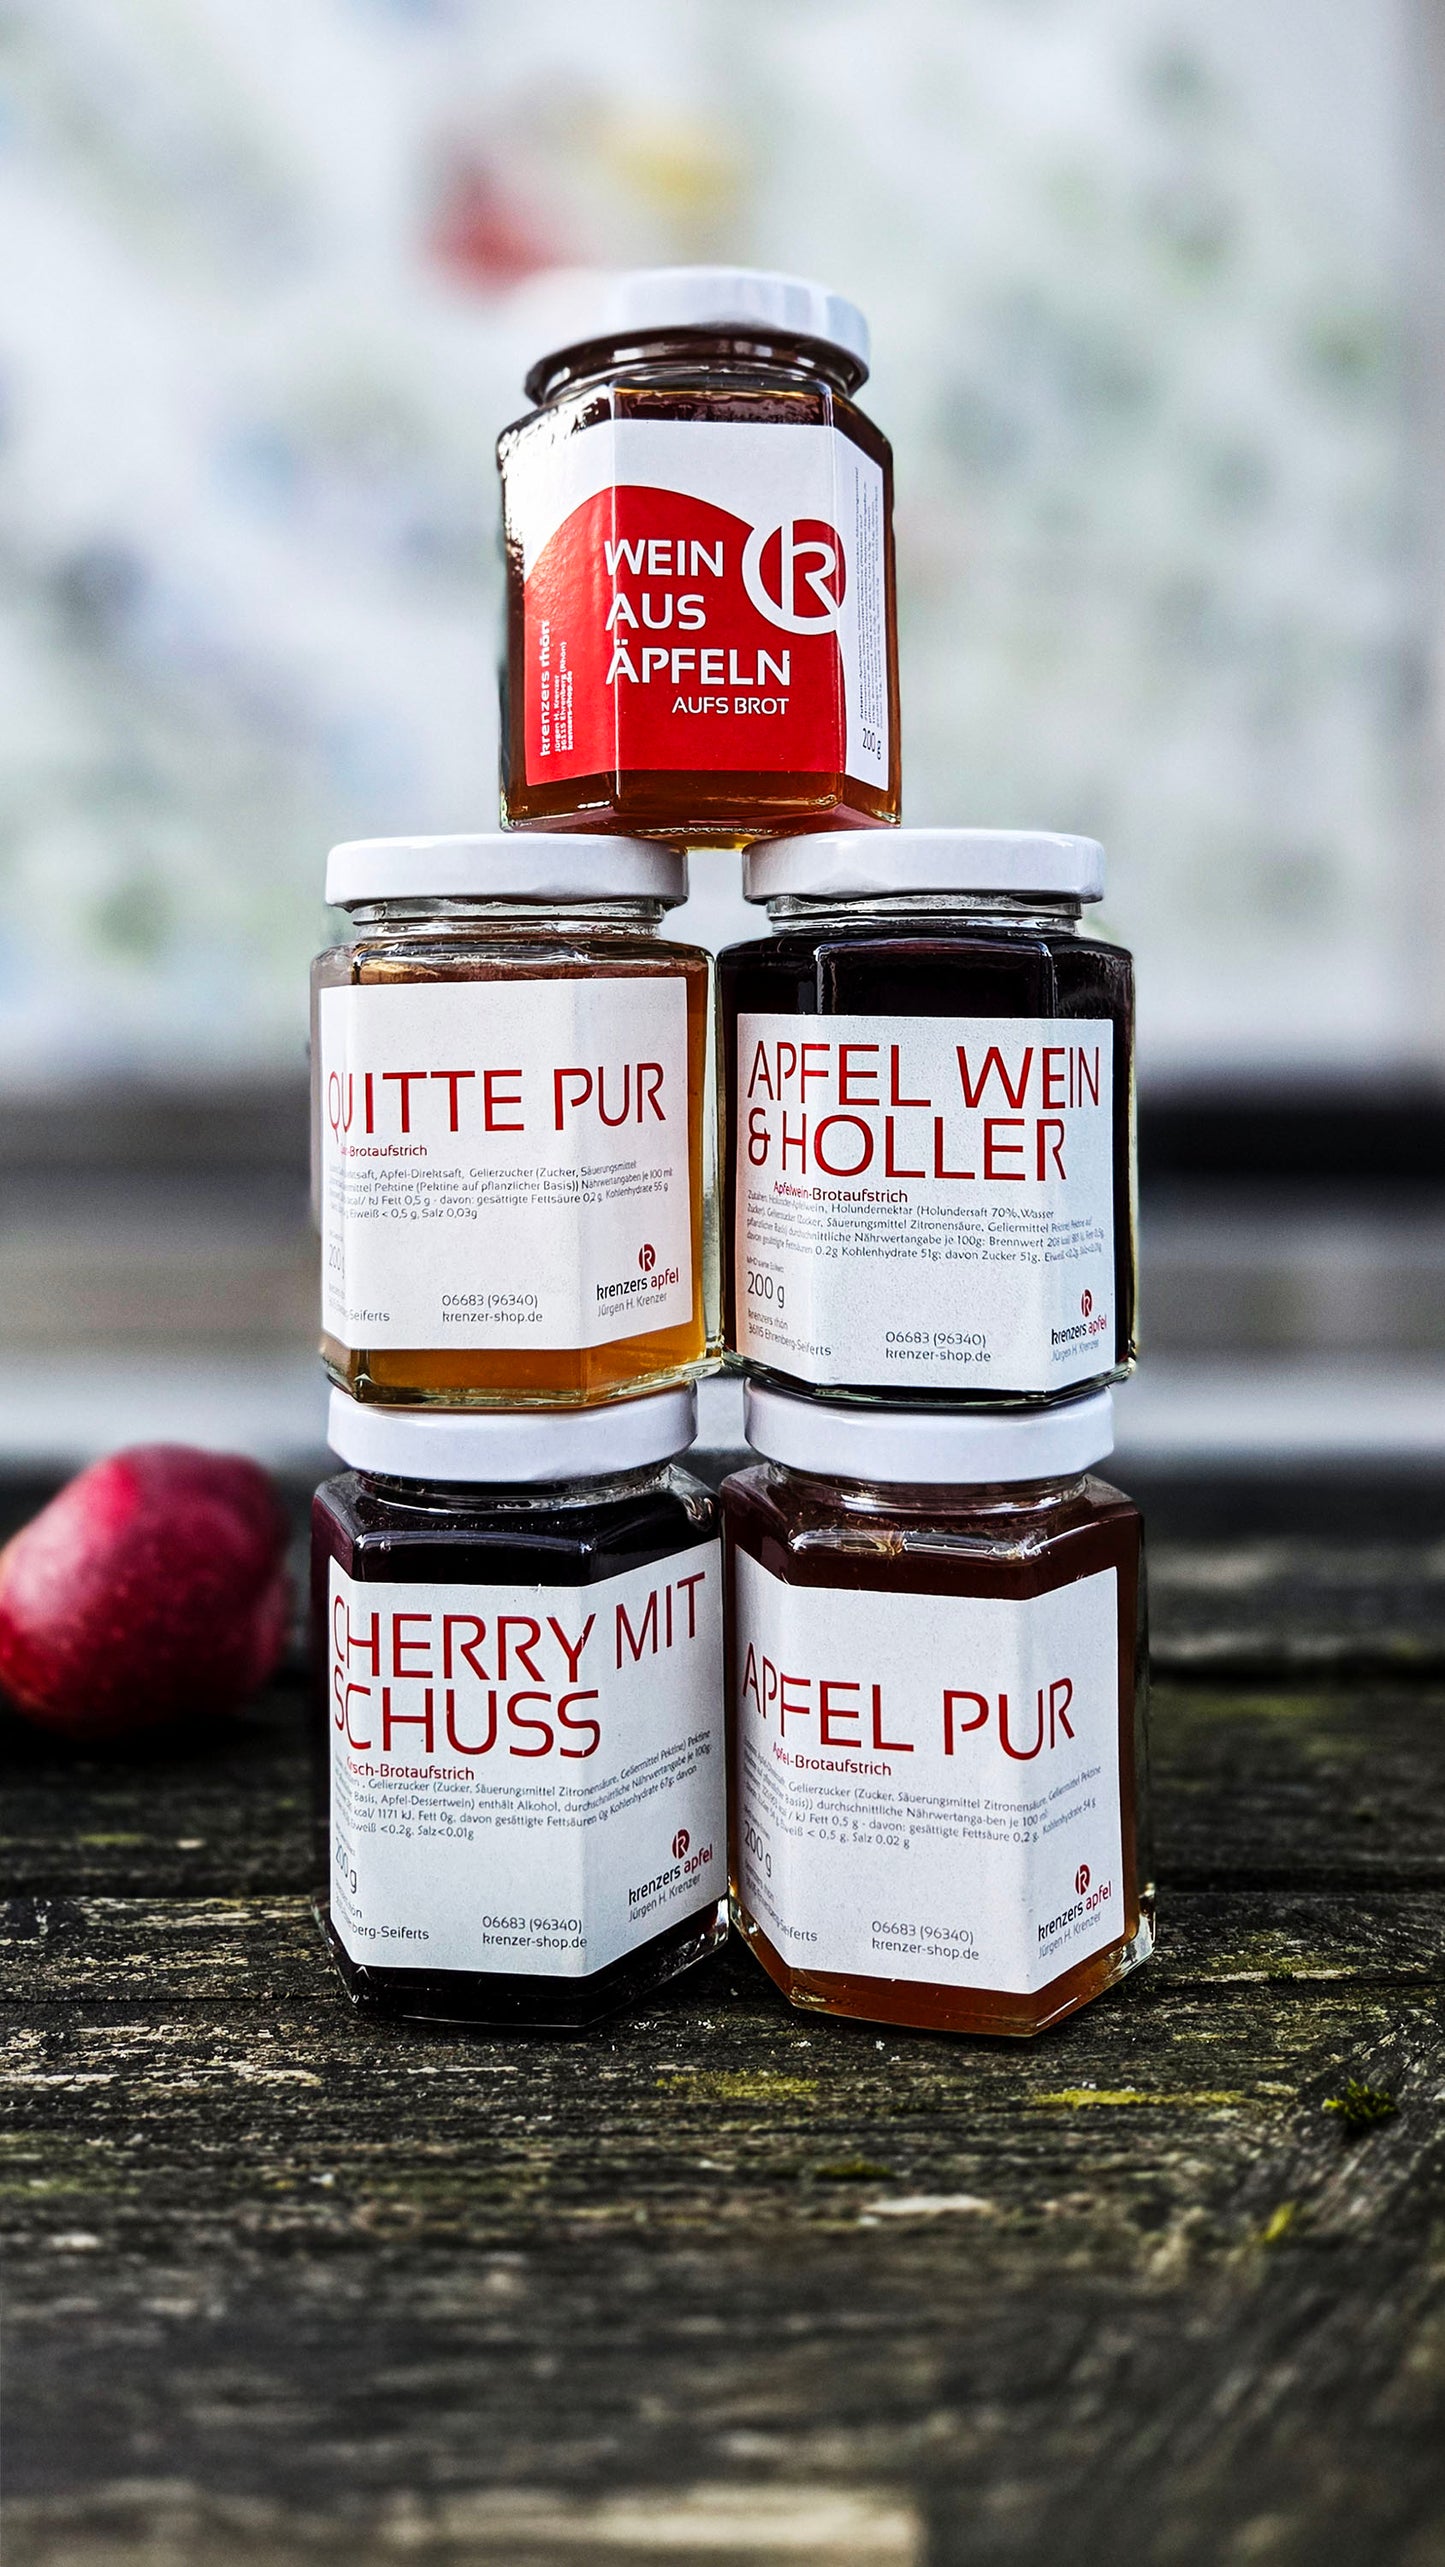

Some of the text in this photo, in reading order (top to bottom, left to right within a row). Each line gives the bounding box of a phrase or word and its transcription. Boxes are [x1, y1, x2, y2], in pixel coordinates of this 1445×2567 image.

[604, 538, 723, 578] WEIN
[604, 593, 706, 630] AUS
[605, 639, 791, 686] ÄPFELN
[540, 671, 551, 756] krenzers
[672, 697, 789, 715] AUFS BROT
[747, 1039, 1101, 1110] APFEL WEIN
[328, 1062, 667, 1142] QUITTE PUR
[747, 1107, 1067, 1182] & HOLLER
[462, 1181, 479, 1191] auf
[773, 1180, 908, 1203] Apfelwein-Brotaufstrich
[421, 1208, 444, 1218] Salz
[423, 1197, 431, 1207] g
[916, 1205, 988, 1217] (Holundersaft
[826, 1216, 907, 1231] Säuerungsmittel
[988, 1221, 1049, 1234] Geliermittel
[854, 1232, 942, 1247] Nährwertangabe
[989, 1236, 1043, 1248] Brennwert
[841, 1246, 918, 1259] Kohlenhydrate
[945, 1249, 979, 1260] davon
[981, 1250, 1017, 1262] Zucker
[596, 1266, 680, 1301] krenzers apfel
[747, 1270, 785, 1309] 200 g
[442, 1293, 538, 1309] 06683 (96340)
[597, 1301, 625, 1318] Jürgen
[636, 1292, 668, 1308] Krenzer
[442, 1311, 543, 1324] krenzer-shop.de
[1050, 1313, 1107, 1346] krenzers apfel
[885, 1330, 987, 1349] 06683 (96340)
[885, 1347, 991, 1363] krenzer-shop.de
[333, 1571, 706, 1683] CHERRY MIT
[333, 1664, 601, 1759] SCHUSS
[742, 1641, 1076, 1762] APFEL PUR
[368, 1778, 430, 1791] Gelierzucker
[475, 1783, 556, 1798] Säuerungsmittel
[788, 1781, 850, 1796] Gelierzucker
[898, 1791, 981, 1809] Säuerungsmittel
[418, 1811, 437, 1822] Fett
[459, 1813, 492, 1824] davon
[478, 1799, 514, 1811] enthält
[809, 1814, 828, 1825] Fett
[744, 1820, 763, 1862] 200
[765, 1852, 772, 1878] g
[852, 1831, 873, 1843] Salz
[628, 1843, 713, 1906] krenzers apfel
[628, 1898, 658, 1923] Jürgen
[667, 1873, 702, 1899] Krenzer
[1037, 1880, 1113, 1942] krenzers apfel
[482, 1915, 583, 1934] 06683 (96340)
[871, 1919, 975, 1946] 06683 (96340)
[1072, 1911, 1103, 1937] Krenzer
[482, 1932, 588, 1951] krenzer-shop.de
[871, 1936, 980, 1961] krenzer-shop.de
